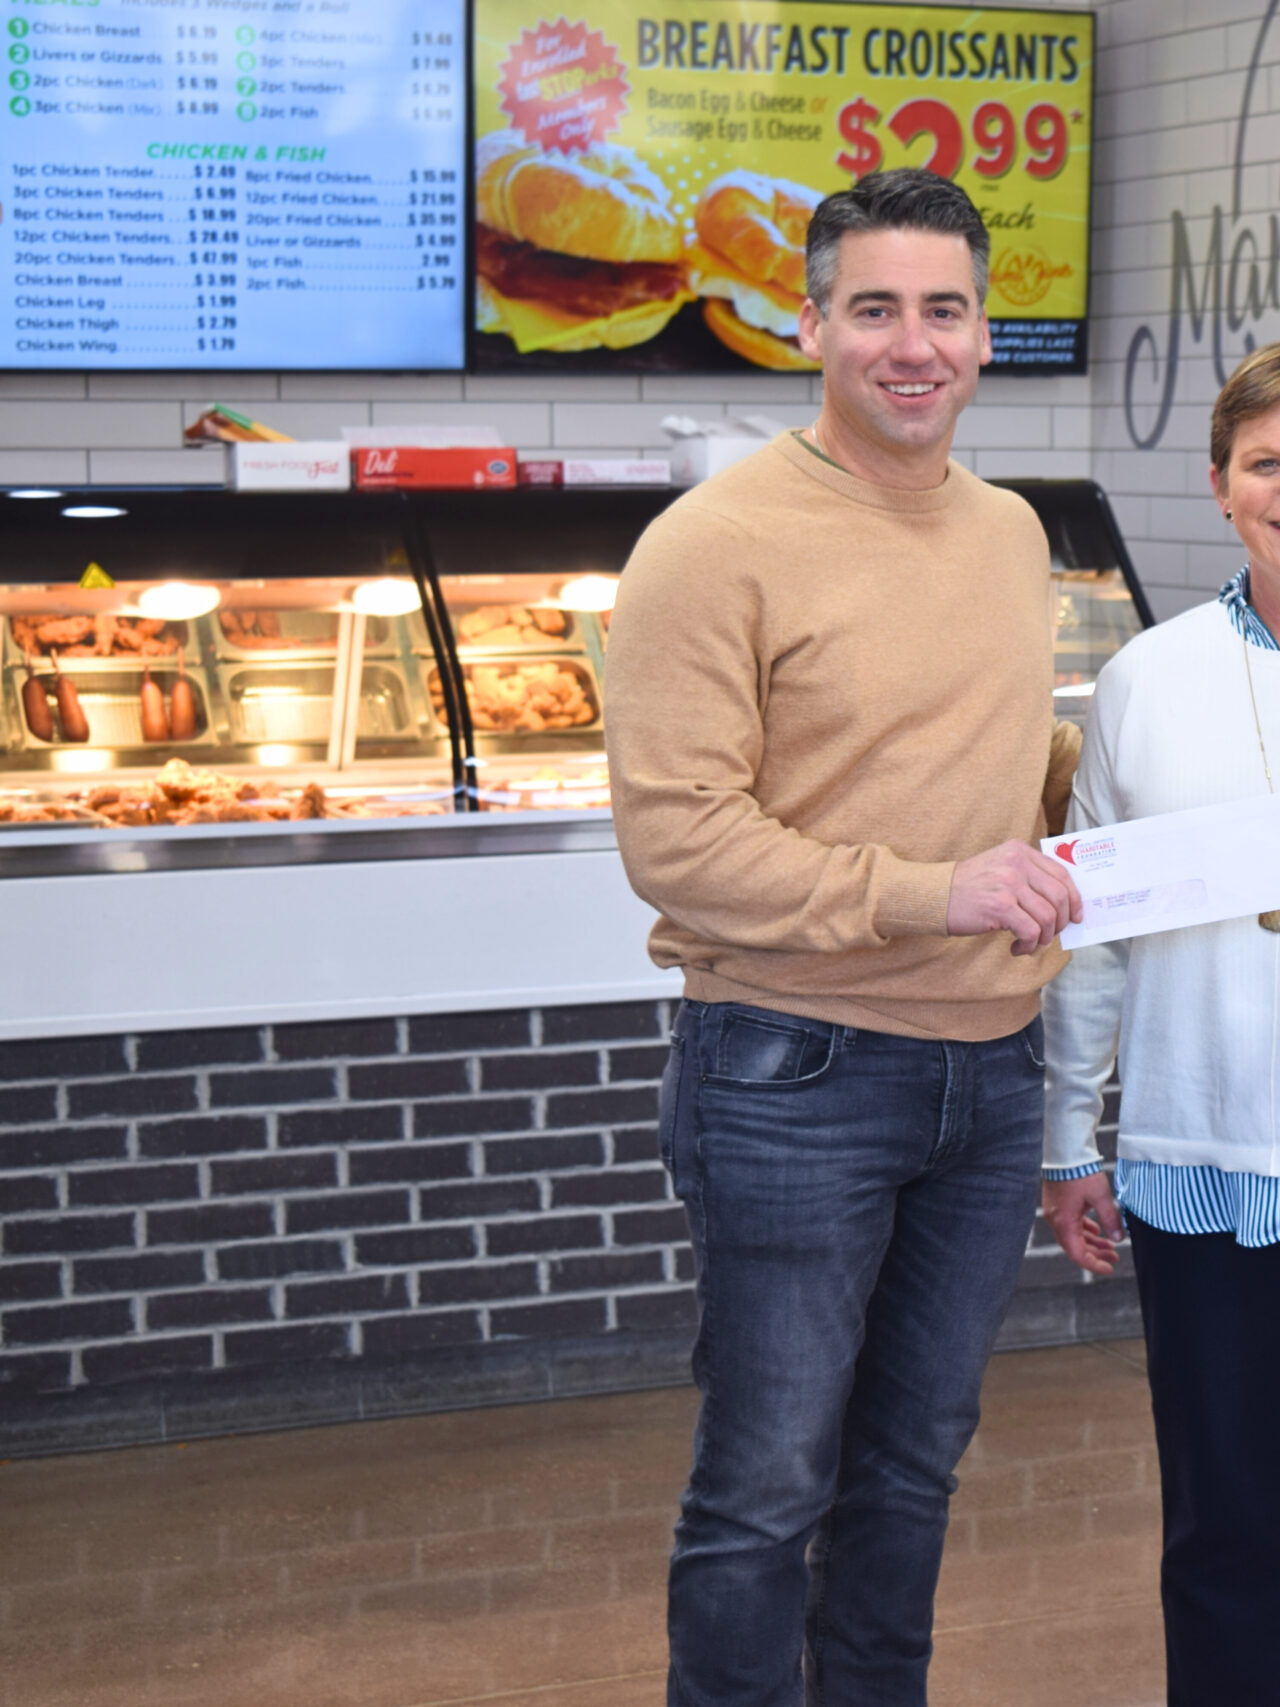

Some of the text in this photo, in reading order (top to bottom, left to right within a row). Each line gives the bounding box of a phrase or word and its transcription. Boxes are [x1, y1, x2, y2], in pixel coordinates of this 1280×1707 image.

[32, 22, 91, 34] Chicken
[95, 24, 140, 37] Breast
[291, 31, 346, 42] Chicken
[33, 48, 76, 61] Livers
[81, 52, 95, 61] or
[100, 50, 162, 63] Gizzards
[637, 19, 851, 75] BREAKFAST
[863, 28, 1079, 82] CROISSANTS
[34, 75, 59, 88] 2pc
[65, 75, 124, 88] Chicken
[260, 81, 285, 93] 2pc
[291, 82, 345, 94] Tenders
[35, 101, 60, 114] 3pc
[66, 101, 124, 114] Chicken
[647, 88, 827, 115] Bacon Egg & Cheese or
[260, 105, 285, 118] 2pc
[290, 106, 319, 118] Fish
[647, 116, 823, 143] Sausage Egg & Cheese
[146, 143, 327, 161] CHICKEN & FISH
[12, 164, 37, 177] 1pc
[41, 164, 101, 177] Chicken
[105, 166, 154, 178] Tender
[245, 171, 270, 183] 8pc
[276, 171, 312, 183] Fried
[316, 172, 372, 183] Chicken
[13, 186, 40, 199] 3pc
[44, 186, 104, 199] Chicken
[108, 188, 164, 200] Tenders
[246, 192, 276, 205] 12pc
[282, 192, 318, 205] Fried
[322, 193, 378, 205] Chicken
[13, 208, 40, 221] 8pc
[45, 208, 104, 221] Chicken
[108, 210, 164, 222] Tenders
[246, 213, 281, 226] 20pc
[286, 214, 322, 226] Fried
[326, 214, 381, 226] Chicken
[14, 230, 47, 243] 12pc
[52, 230, 110, 243] Chicken
[115, 232, 170, 244] Tenders
[246, 235, 280, 247] Liver
[285, 238, 298, 247] or
[303, 236, 361, 248] Gizzards
[15, 252, 51, 265] 20pc
[57, 252, 115, 265] Chicken
[120, 254, 175, 266] Tenders
[247, 257, 269, 269] 1pc
[274, 256, 302, 268] Fish
[15, 274, 73, 286] Chicken
[77, 275, 123, 286] Breast
[247, 278, 271, 290] 2pc
[276, 278, 305, 289] Fish
[15, 296, 73, 308] Chicken
[78, 297, 105, 310] Leg
[15, 318, 74, 330] Chicken
[79, 318, 120, 333] Thigh
[1003, 323, 1079, 335] AVAILABILITY
[16, 340, 74, 352] Chicken
[79, 341, 118, 354] Wing
[992, 337, 1044, 349] SUPPLIES
[991, 352, 1010, 363] PER
[243, 460, 279, 471] FRESH
[364, 450, 398, 475] Deli
